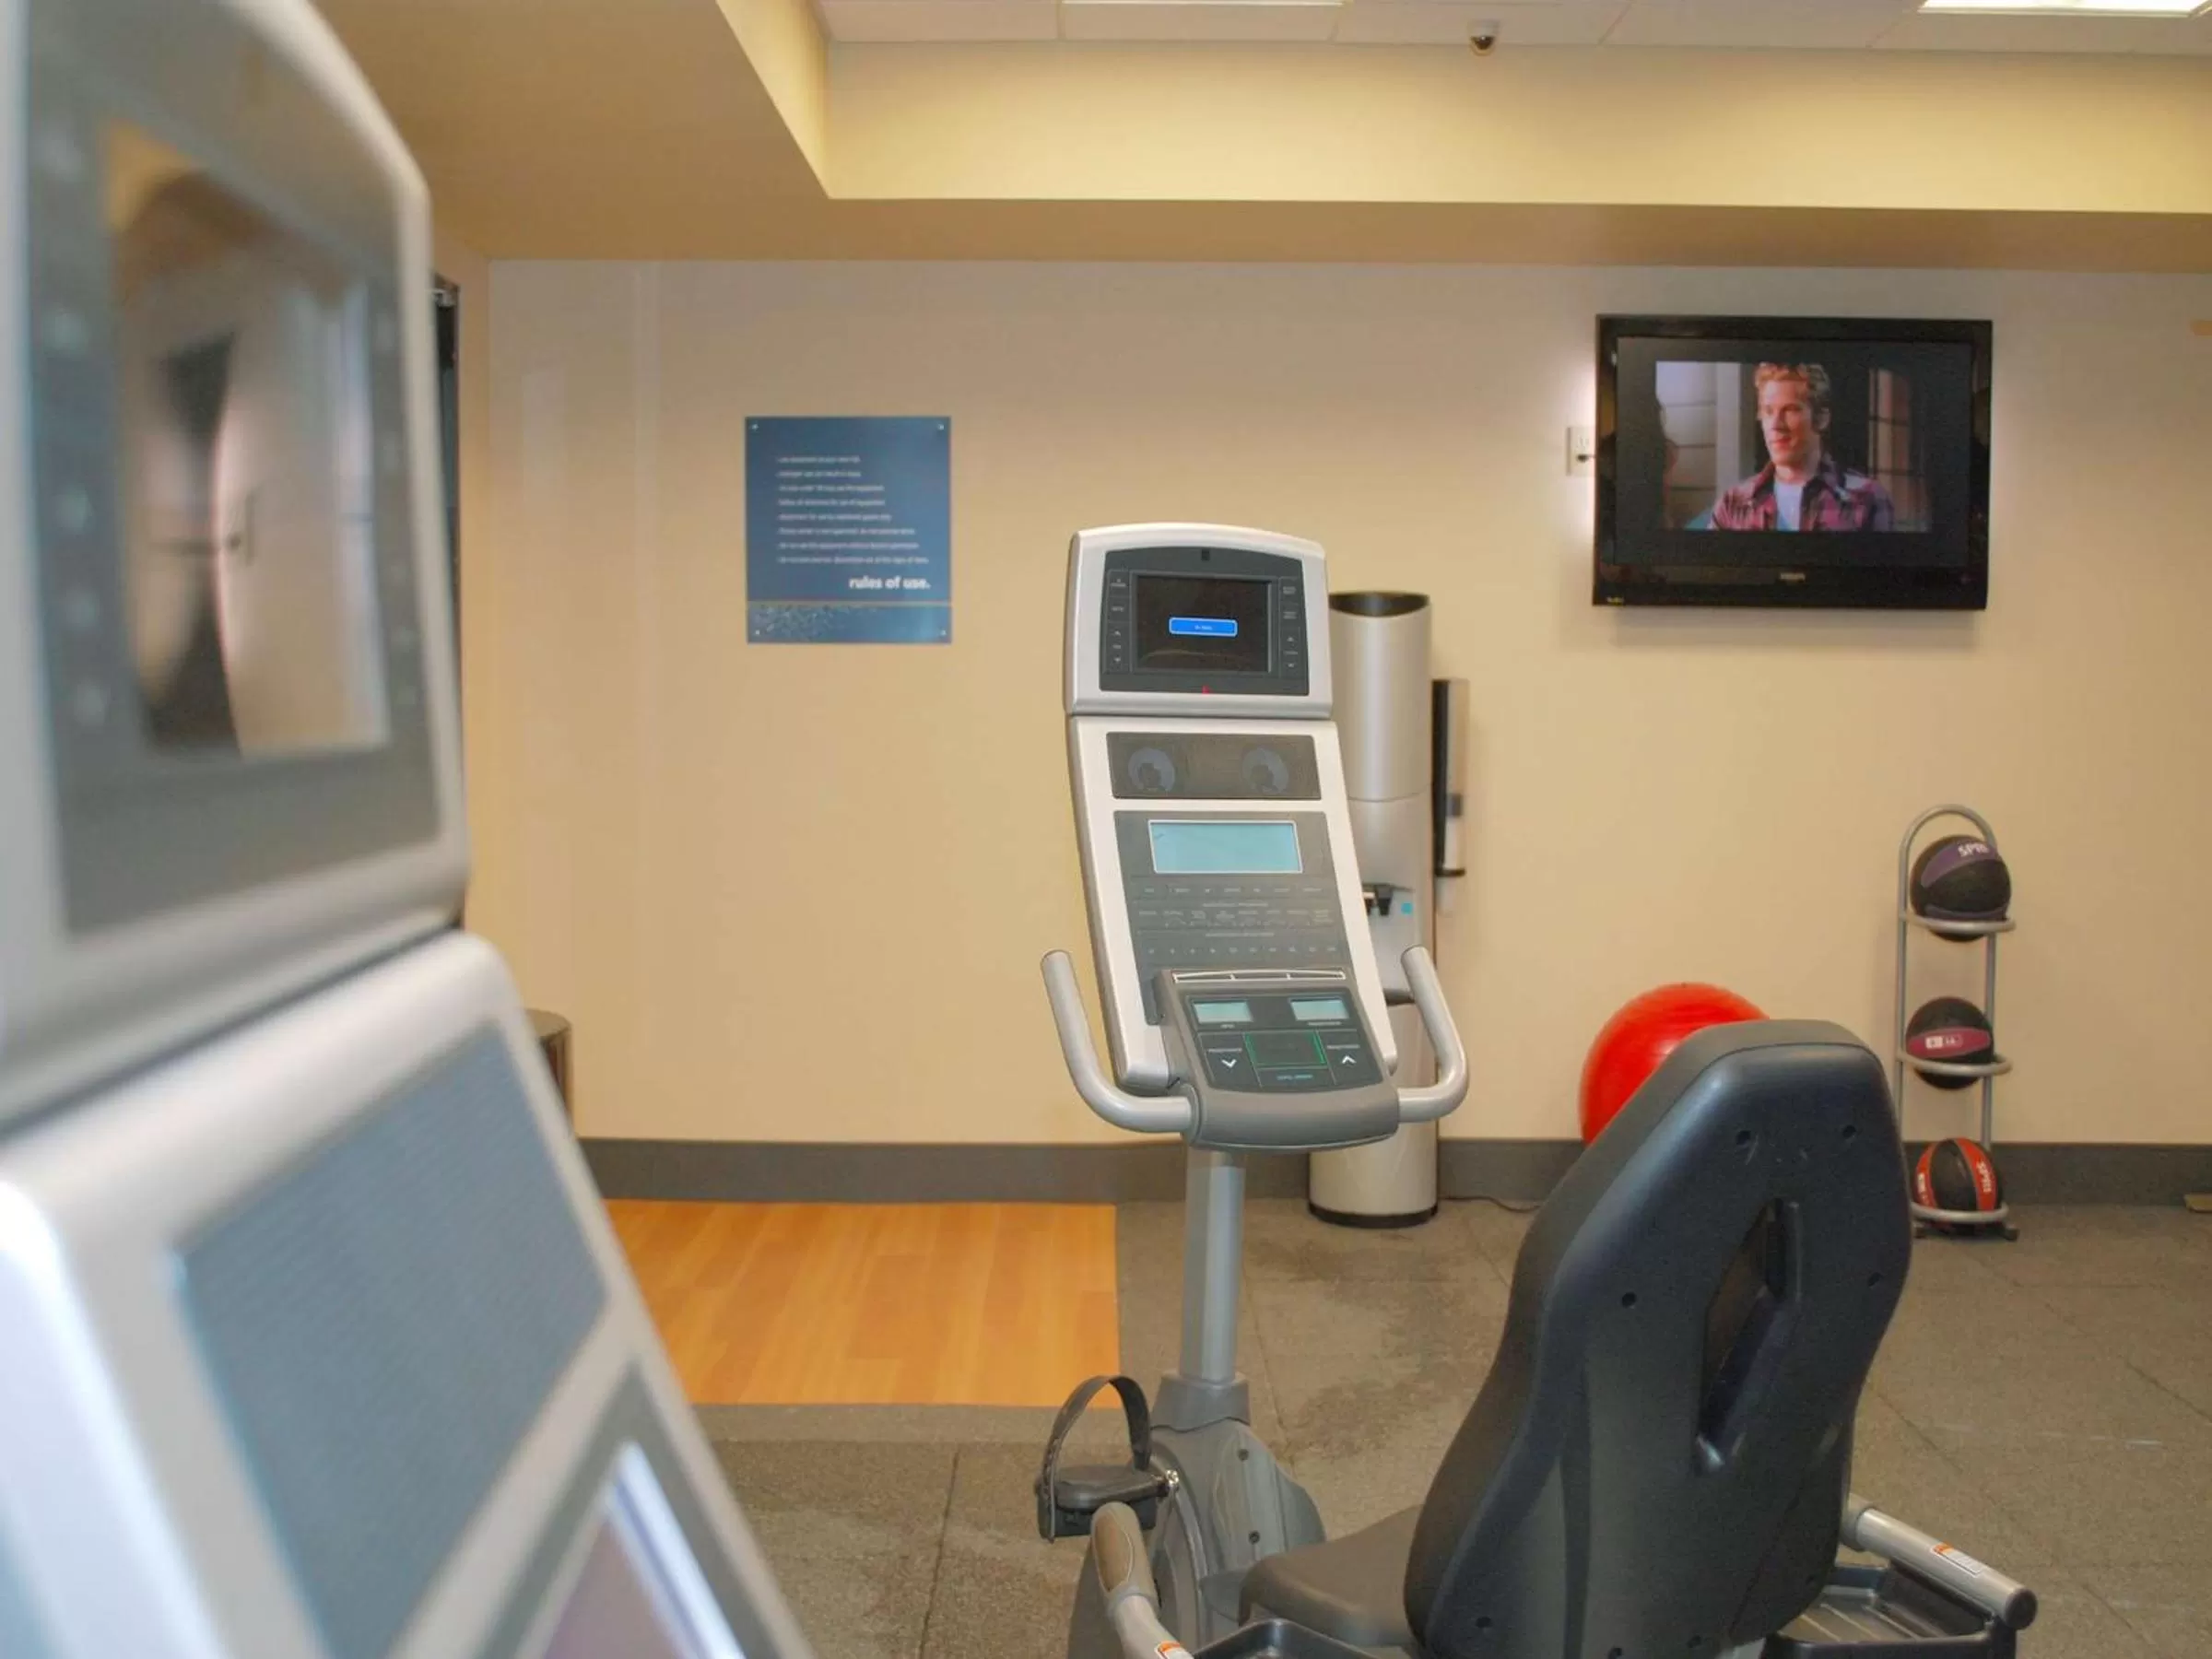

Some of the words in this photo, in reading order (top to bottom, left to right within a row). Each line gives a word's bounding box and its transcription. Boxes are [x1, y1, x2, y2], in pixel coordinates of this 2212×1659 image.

[849, 575, 882, 590] rules
[885, 575, 900, 590] of
[903, 579, 931, 590] use.
